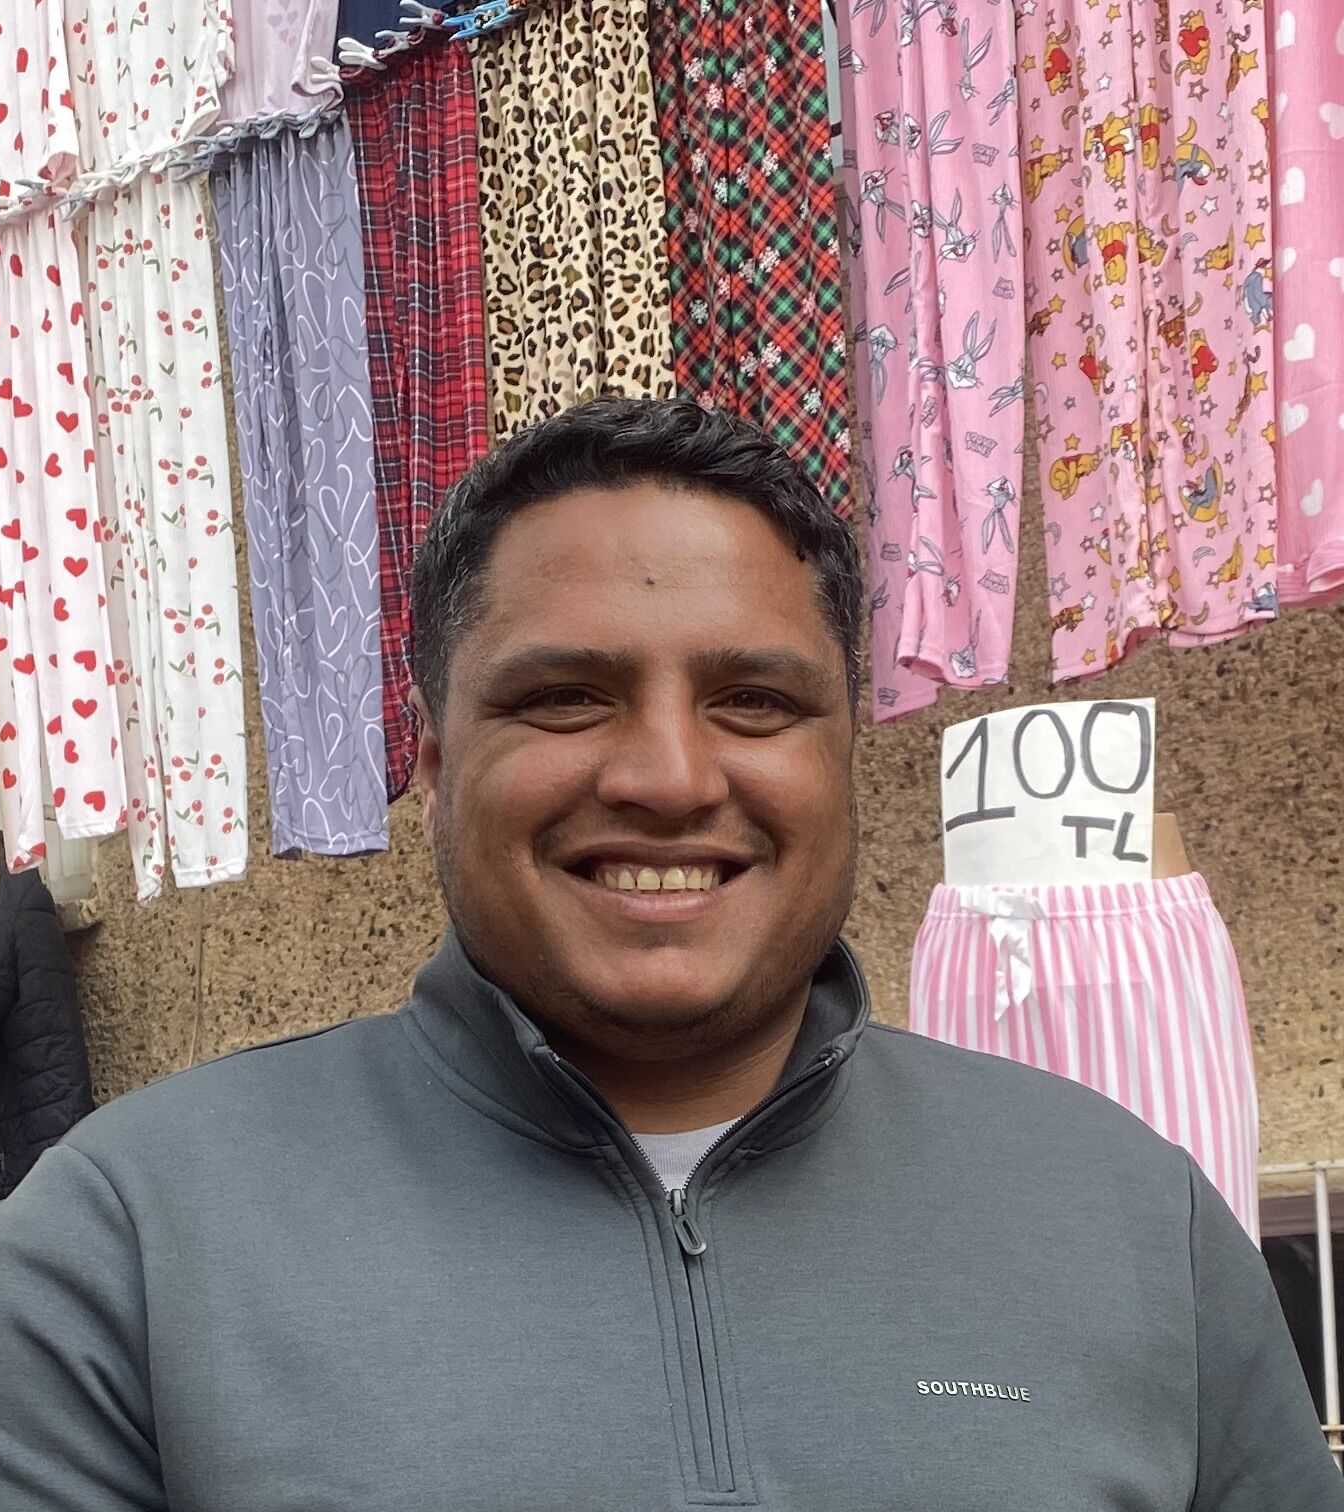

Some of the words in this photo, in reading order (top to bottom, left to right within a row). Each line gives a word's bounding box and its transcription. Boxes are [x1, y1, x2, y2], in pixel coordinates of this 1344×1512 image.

[945, 702, 1152, 832] 100
[1061, 811, 1149, 863] TL
[917, 1380, 1031, 1402] SOUTHBLUE
